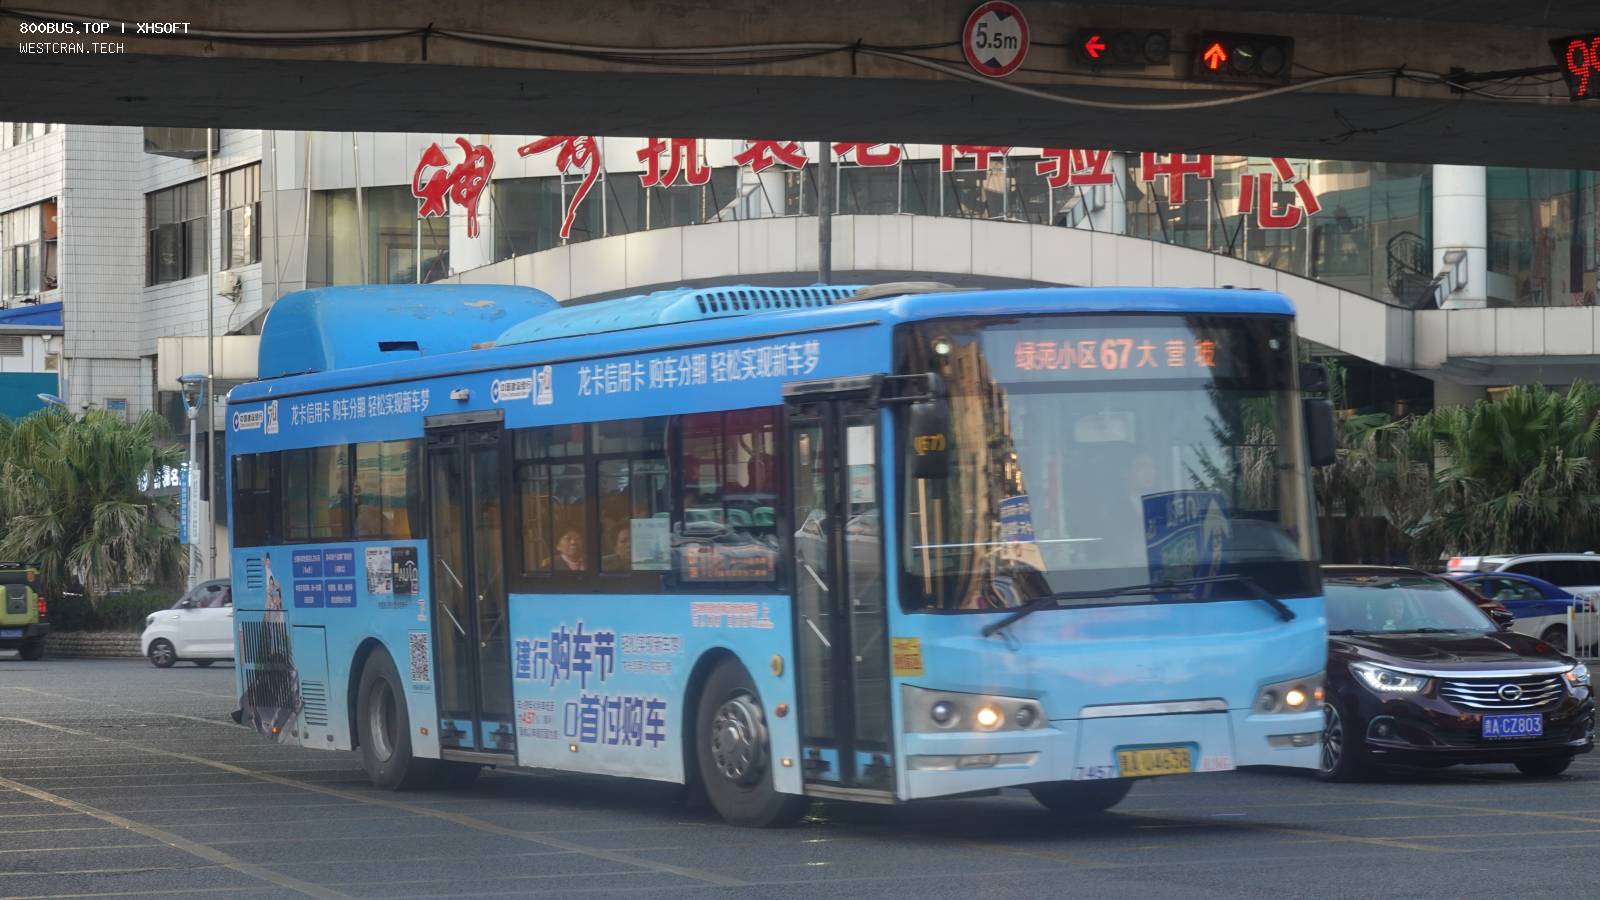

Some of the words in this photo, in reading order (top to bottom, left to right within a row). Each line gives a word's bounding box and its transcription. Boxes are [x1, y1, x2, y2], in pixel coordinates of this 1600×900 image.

[975, 22, 1018, 49] 5.5m
[577, 359, 646, 397] 龙卡信用卡
[649, 352, 707, 389] 购车分期
[711, 339, 821, 384] 轻松实现新车梦
[1101, 338, 1135, 370] 67
[290, 400, 331, 426] 龙卡信用卡
[332, 395, 367, 421] 购车分期
[367, 388, 431, 417] 轻松实现新车梦
[514, 620, 617, 689] 建行购车节
